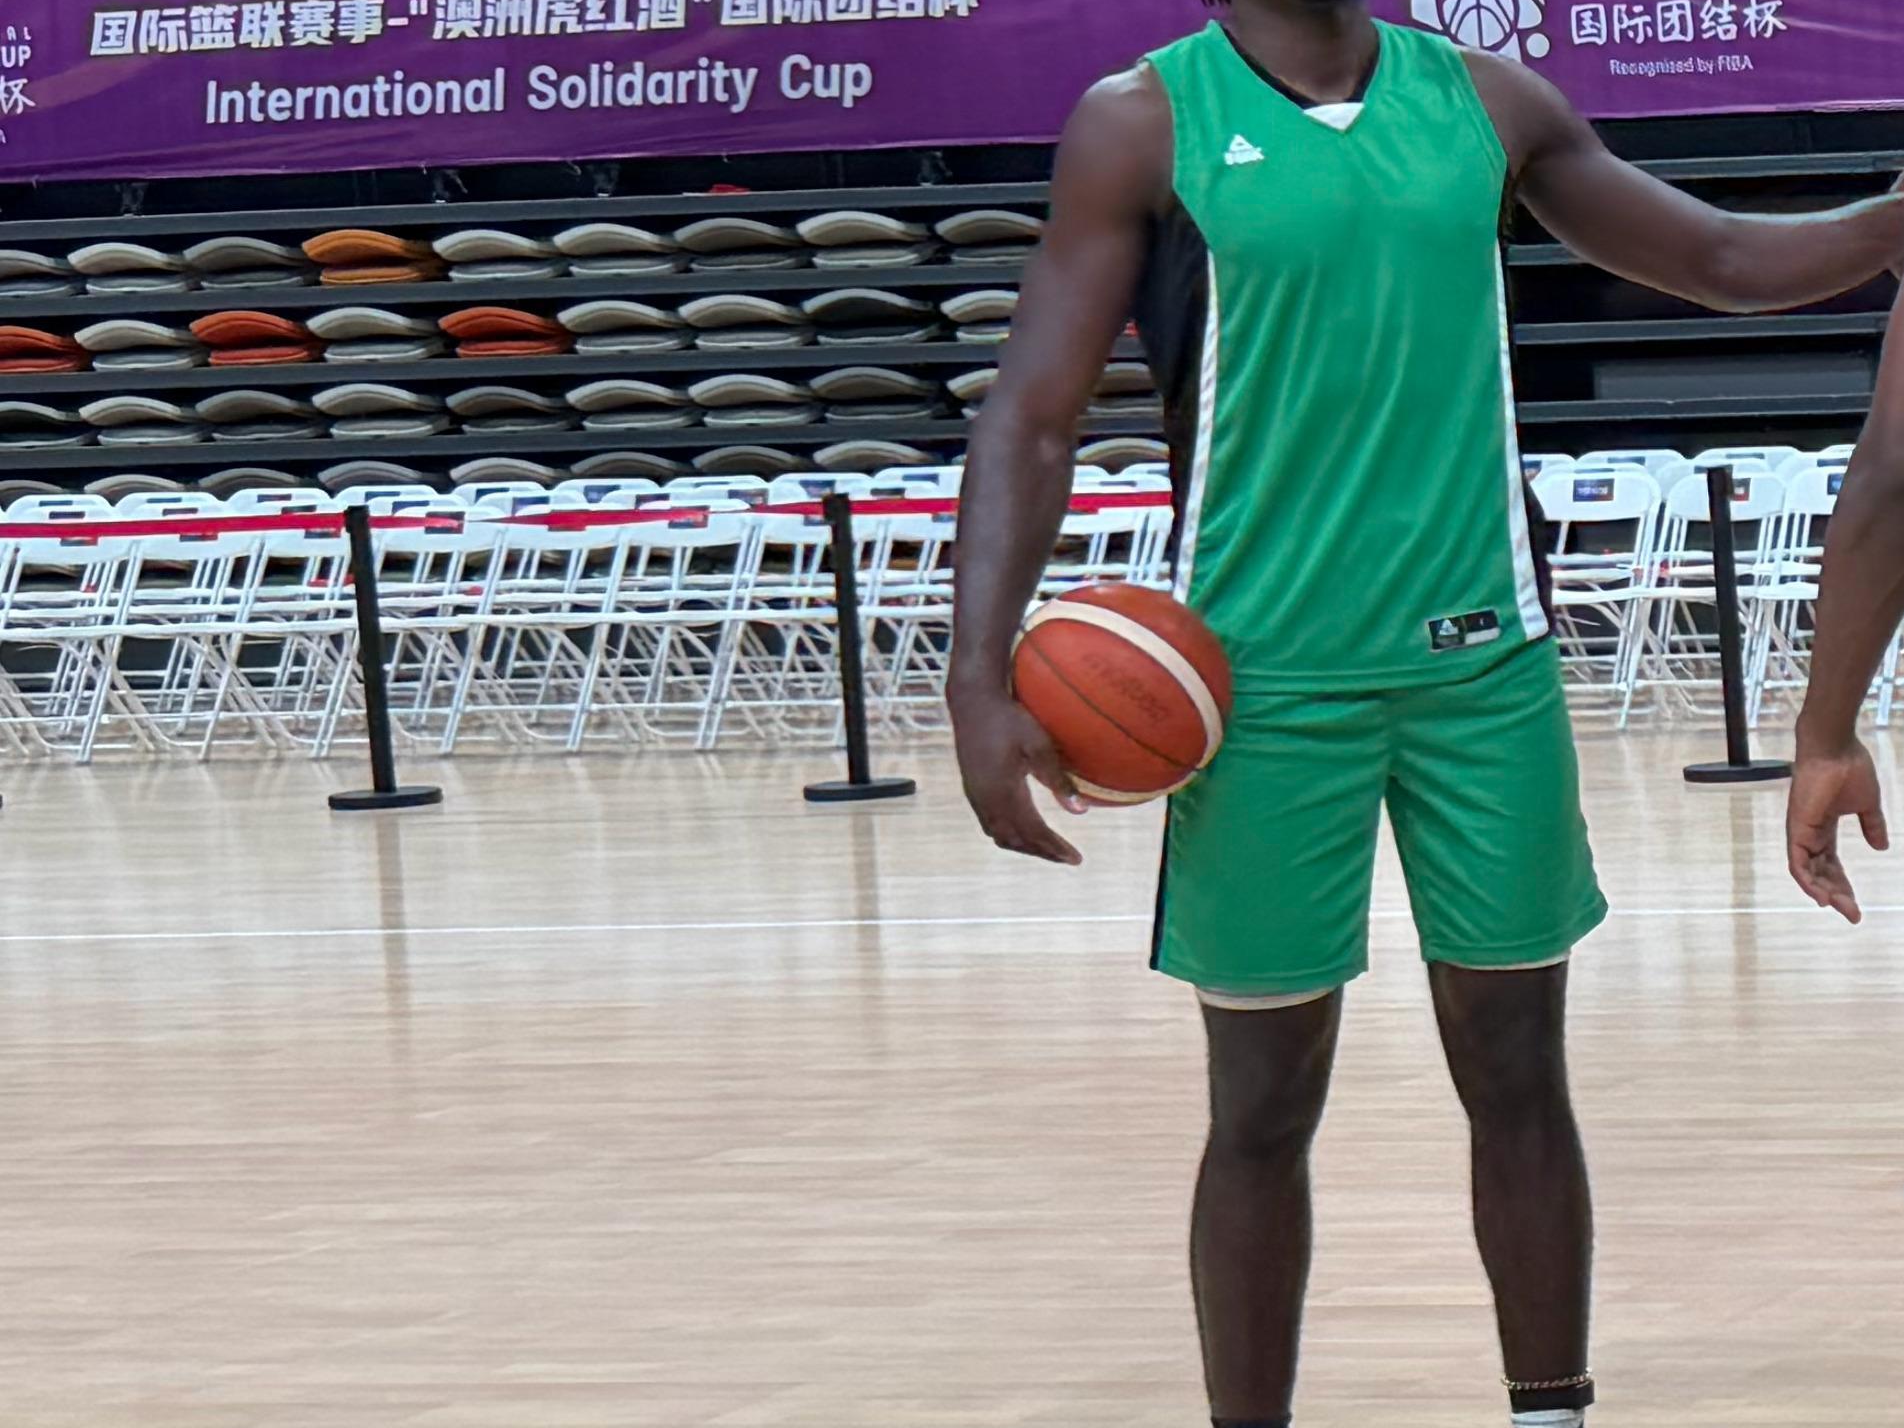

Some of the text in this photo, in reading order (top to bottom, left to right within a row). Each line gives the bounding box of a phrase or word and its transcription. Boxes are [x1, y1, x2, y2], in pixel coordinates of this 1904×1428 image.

[0, 44, 32, 68] UP
[205, 53, 873, 124] International Solidarity Cup
